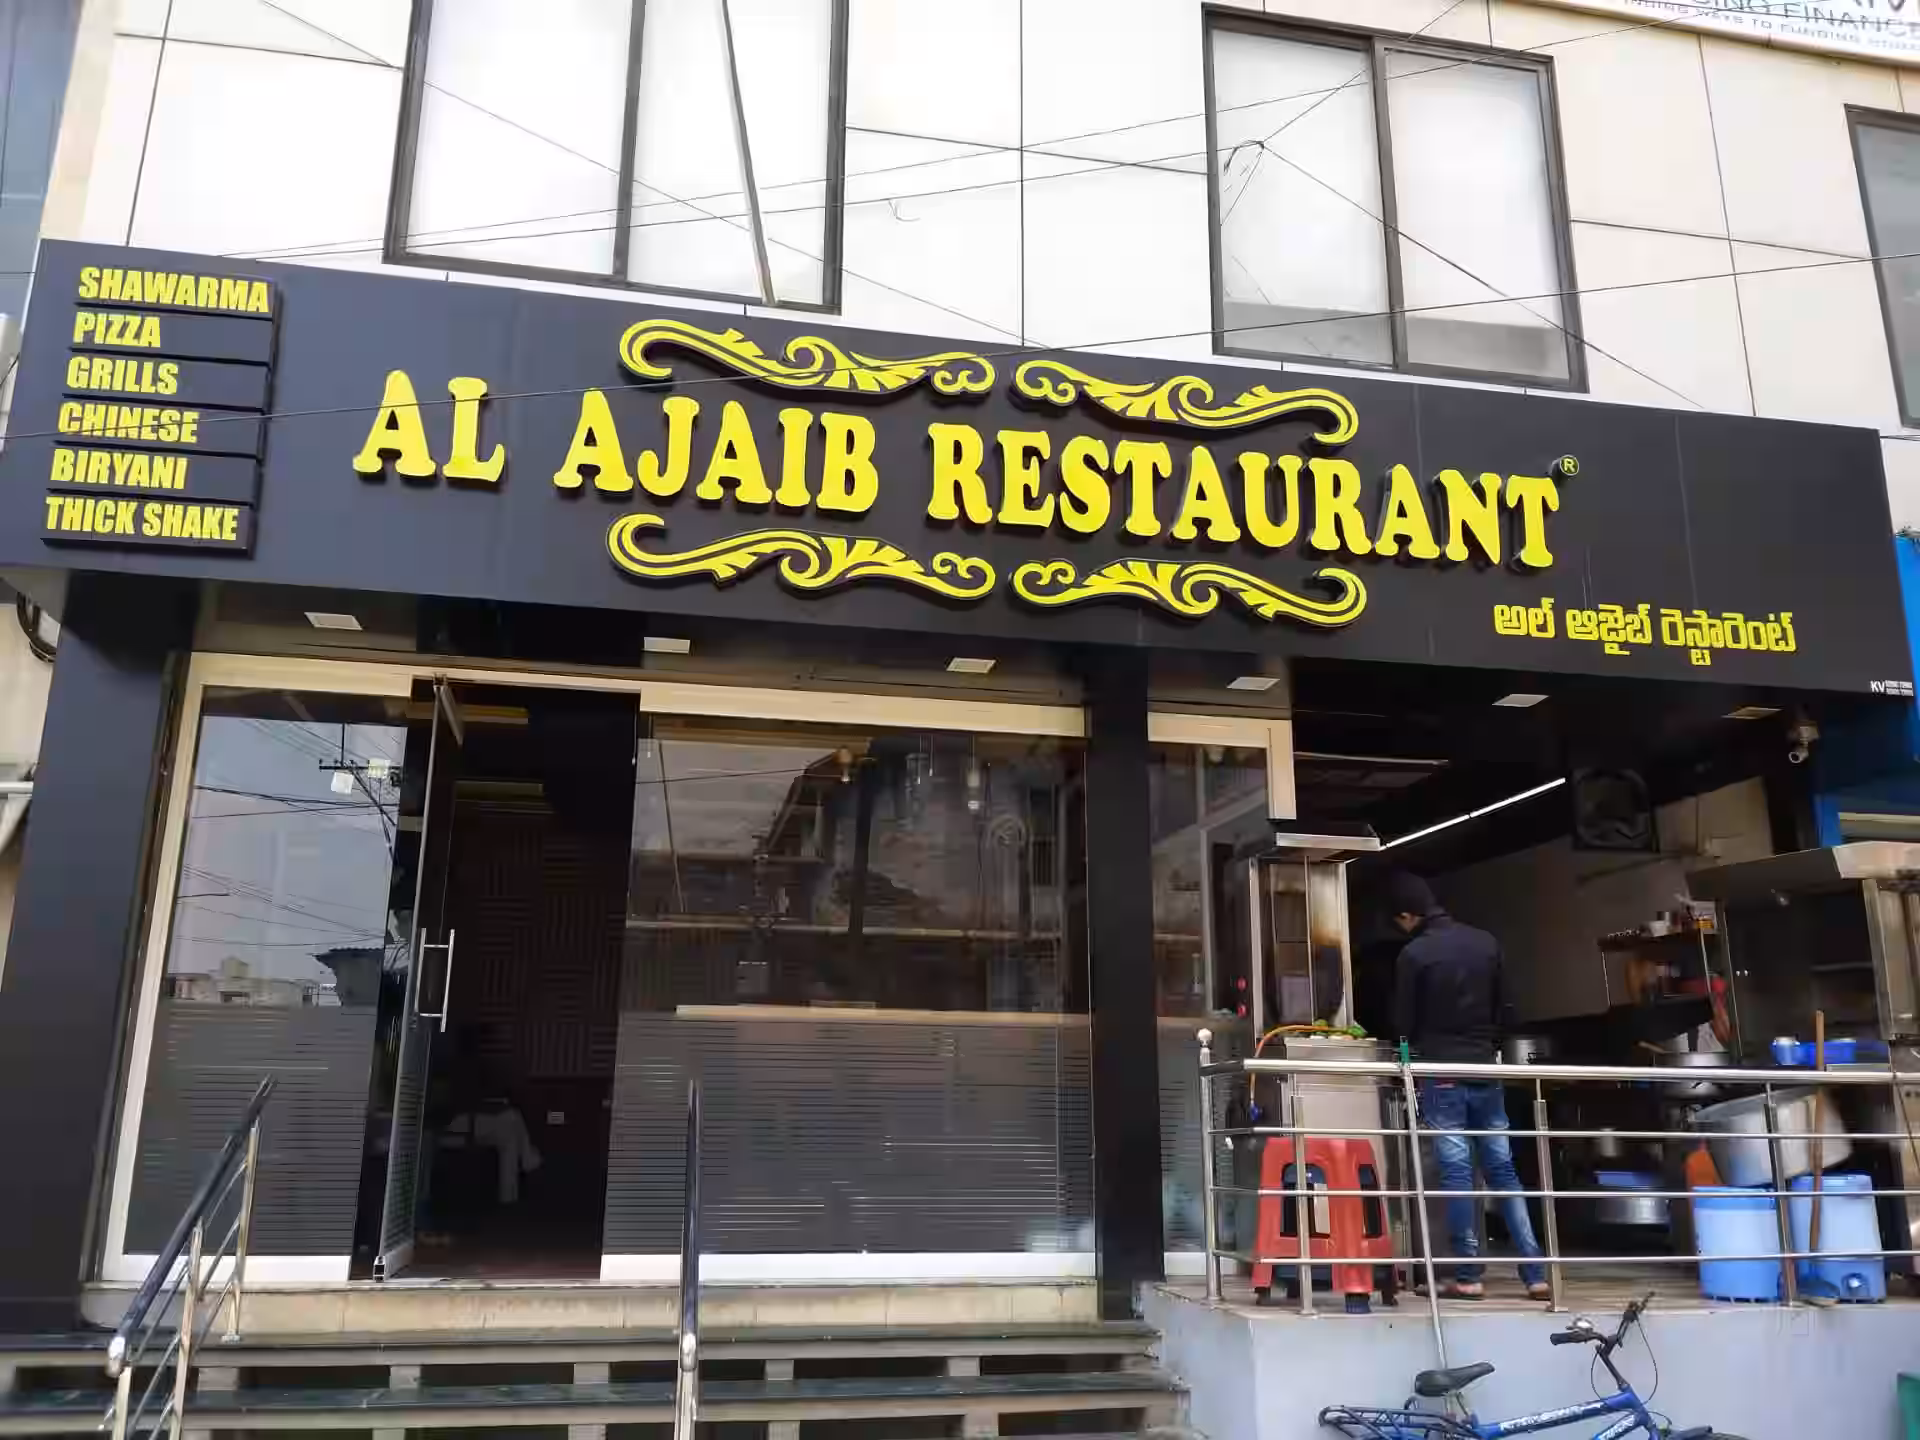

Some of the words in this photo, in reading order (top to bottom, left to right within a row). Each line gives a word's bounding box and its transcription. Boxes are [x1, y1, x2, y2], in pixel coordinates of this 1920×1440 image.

[78, 267, 269, 312] SHAWARMA
[73, 311, 161, 348] PIZZA
[66, 356, 179, 395] GRILLS
[57, 402, 199, 444] CHINESE
[51, 448, 189, 490] BIRYANI
[352, 369, 506, 483] AL
[553, 389, 880, 513] AJAIB
[926, 422, 1561, 569] RESTAURANT
[45, 496, 138, 535] THICK
[142, 502, 240, 541] SHAKE
[1493, 597, 1556, 639] అల్
